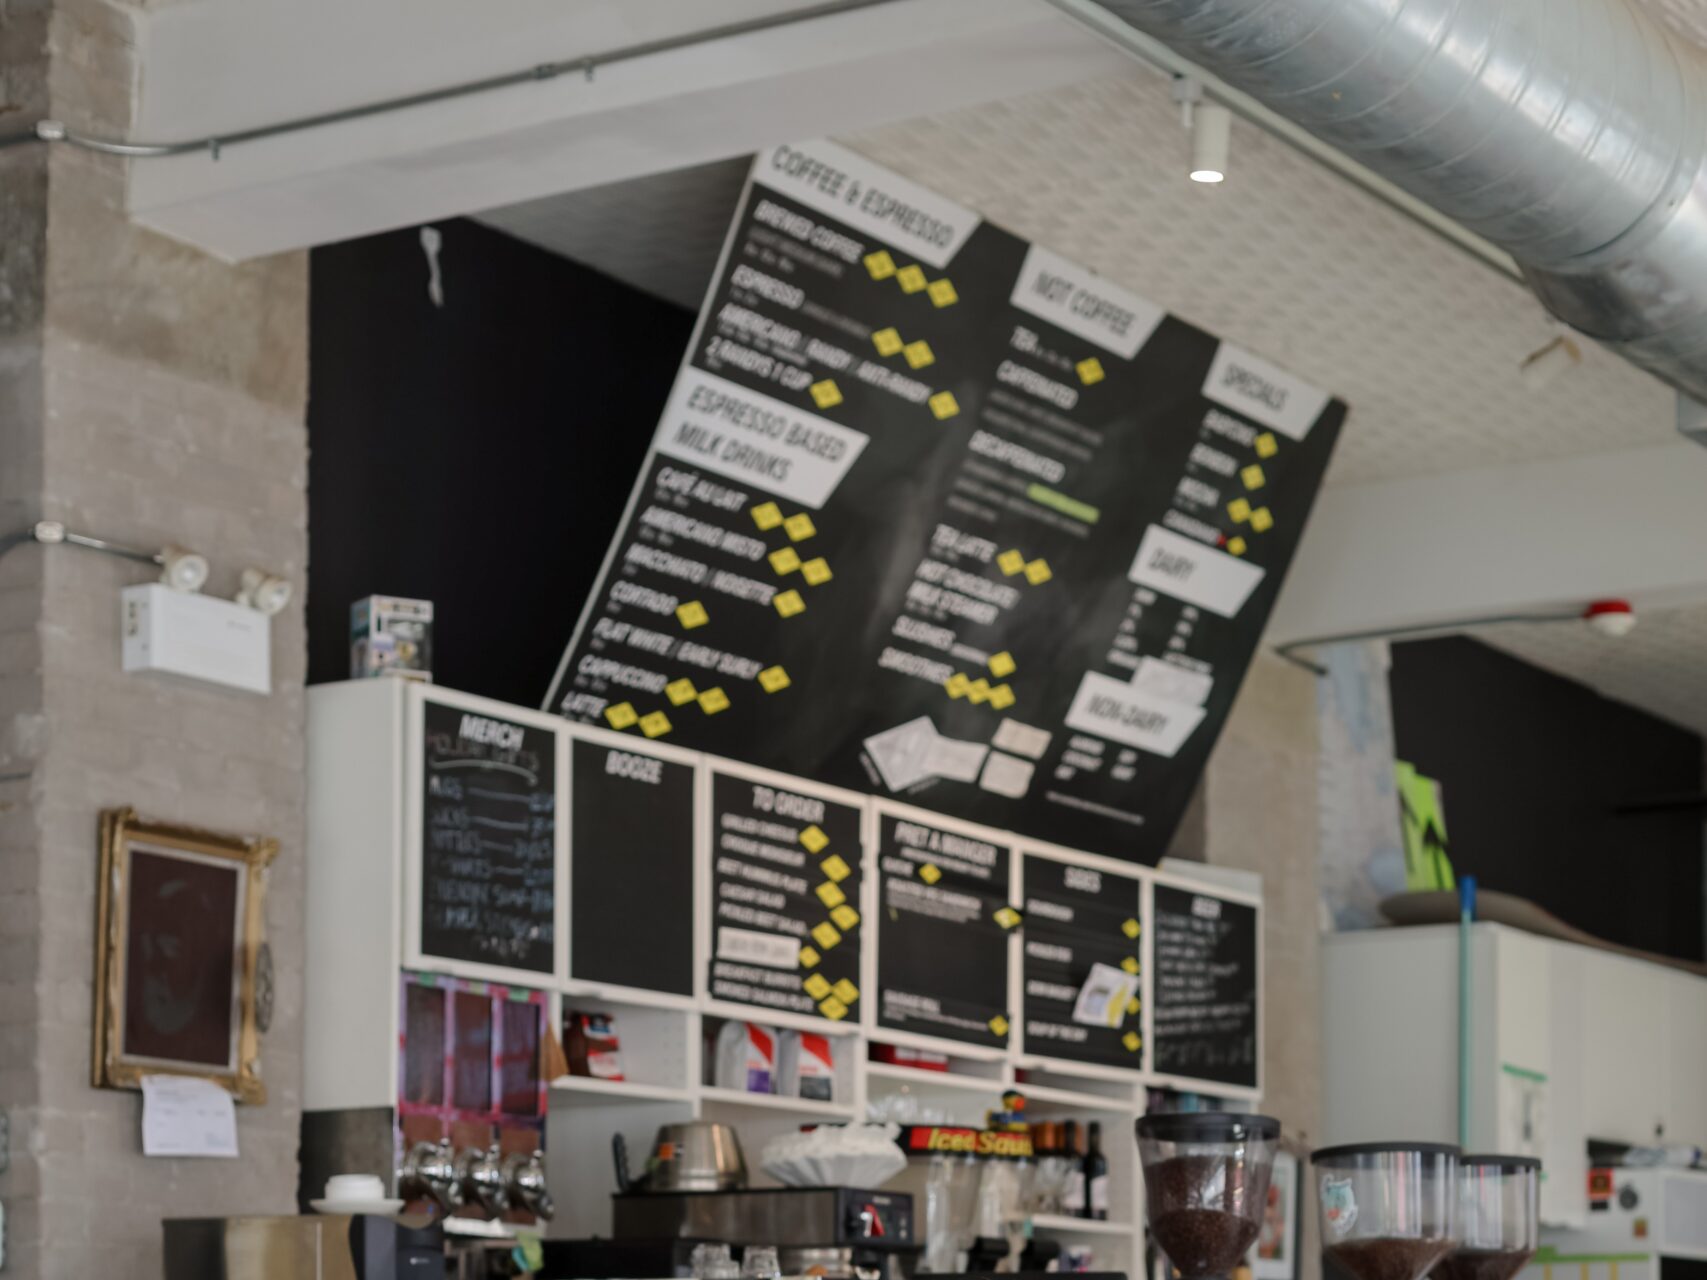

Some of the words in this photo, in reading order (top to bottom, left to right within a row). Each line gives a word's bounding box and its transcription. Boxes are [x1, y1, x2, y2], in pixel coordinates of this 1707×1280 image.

[772, 145, 850, 199] COFFEE
[860, 188, 956, 250] ESPRESSO
[730, 264, 805, 310] ESPRESSO
[1069, 287, 1137, 338] COFFEE
[688, 385, 786, 438] ESPRESSO
[784, 418, 848, 463] BASED
[673, 422, 719, 453] MILK
[718, 438, 794, 482] DRINKS
[460, 714, 525, 751] MERCH
[606, 750, 663, 785] BOOZE
[753, 785, 779, 812] TO
[776, 790, 825, 824] ORDER
[928, 1128, 977, 1151] Iced
